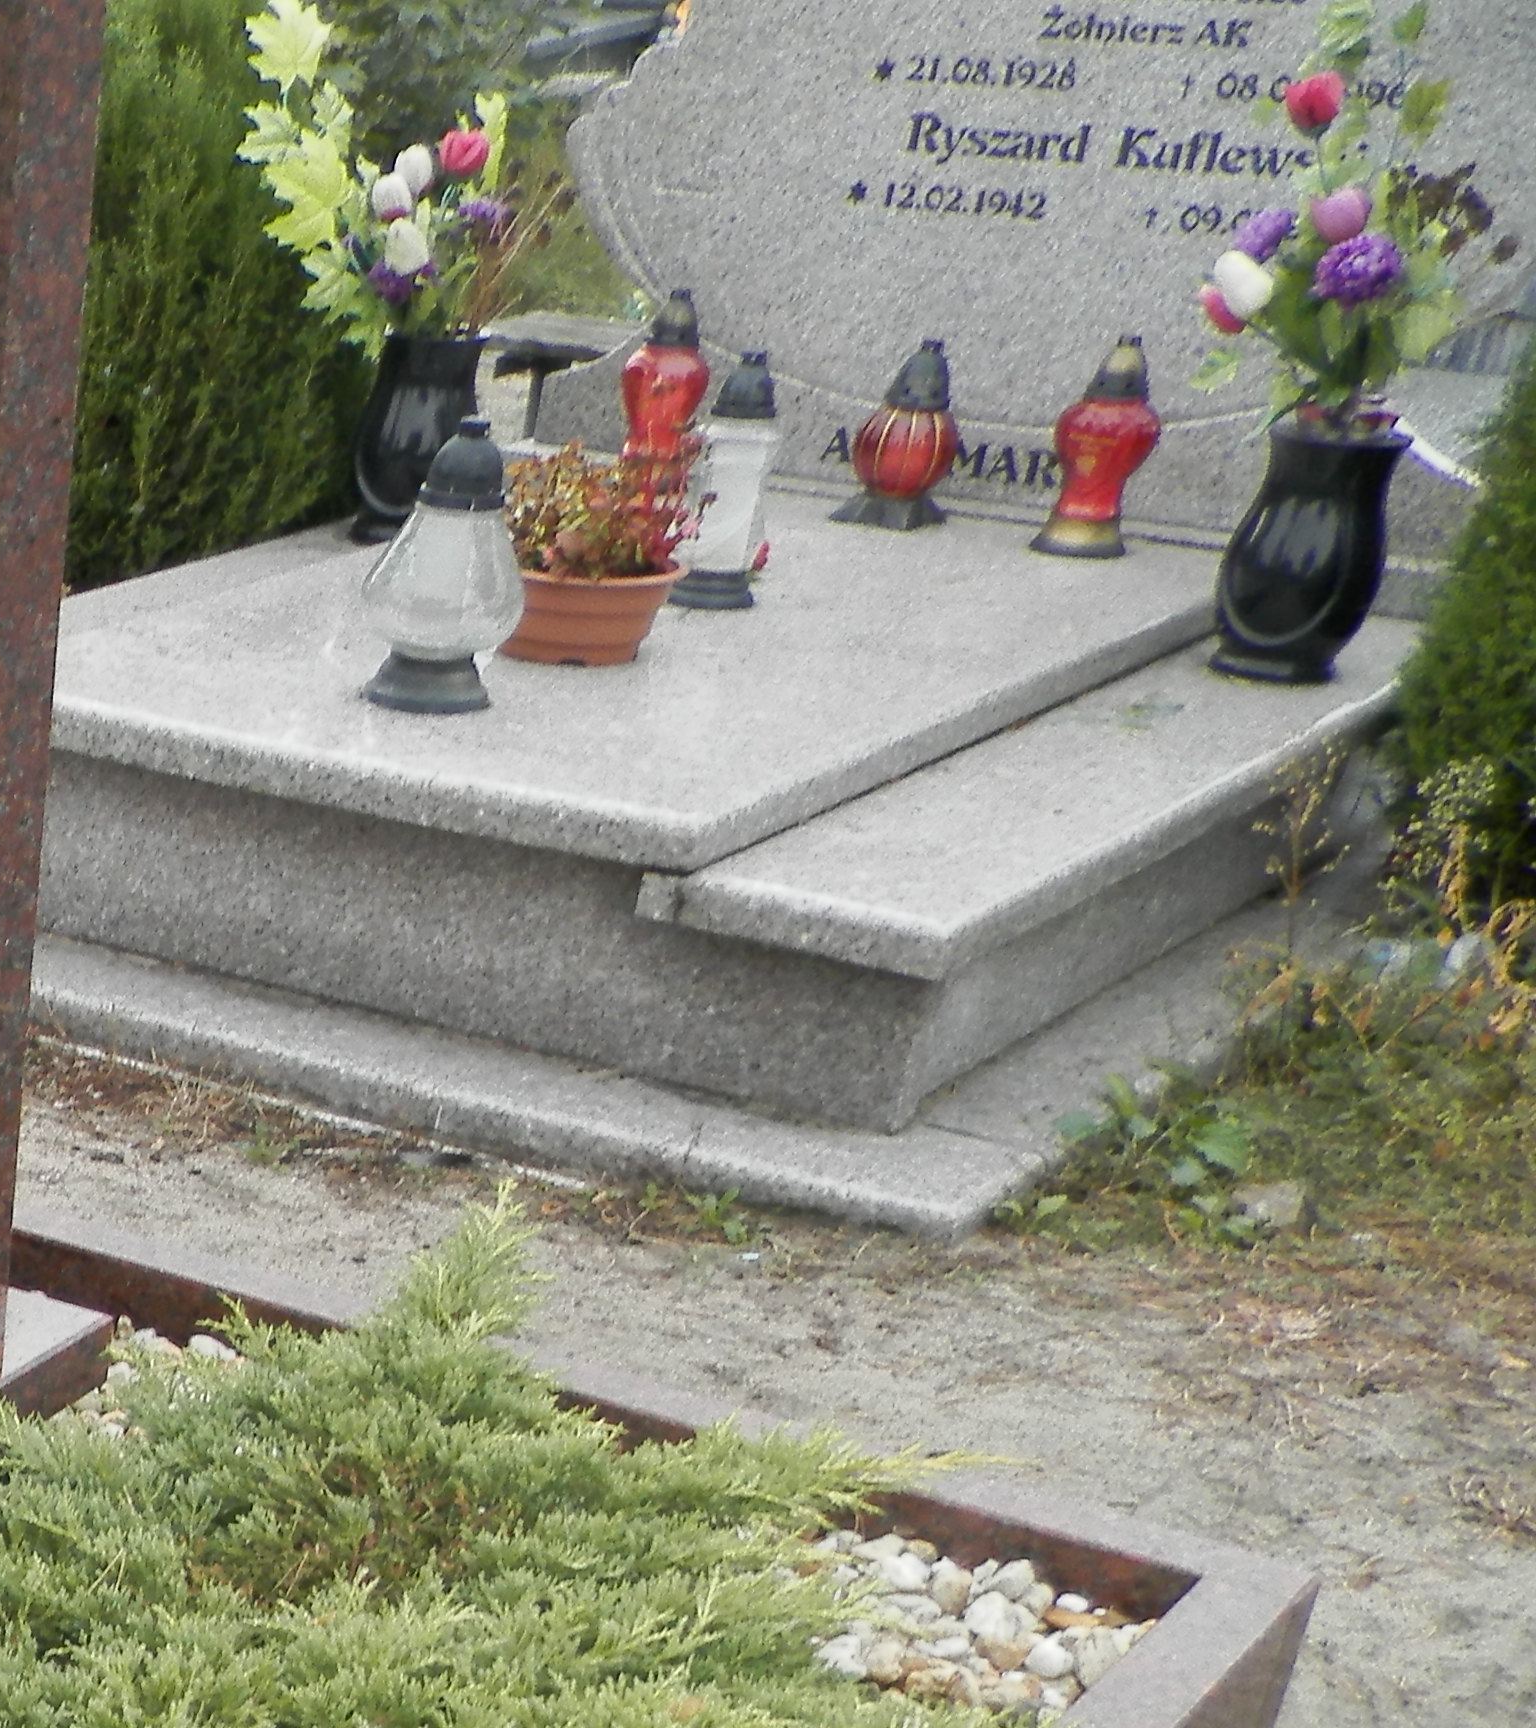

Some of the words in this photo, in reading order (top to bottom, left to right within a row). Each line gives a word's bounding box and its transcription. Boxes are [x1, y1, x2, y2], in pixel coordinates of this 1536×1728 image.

[1194, 18, 1254, 48] AK
[905, 110, 1093, 167] Ryszard
[883, 181, 1048, 221] 12.02.1942
[948, 436, 1063, 489] MAR
